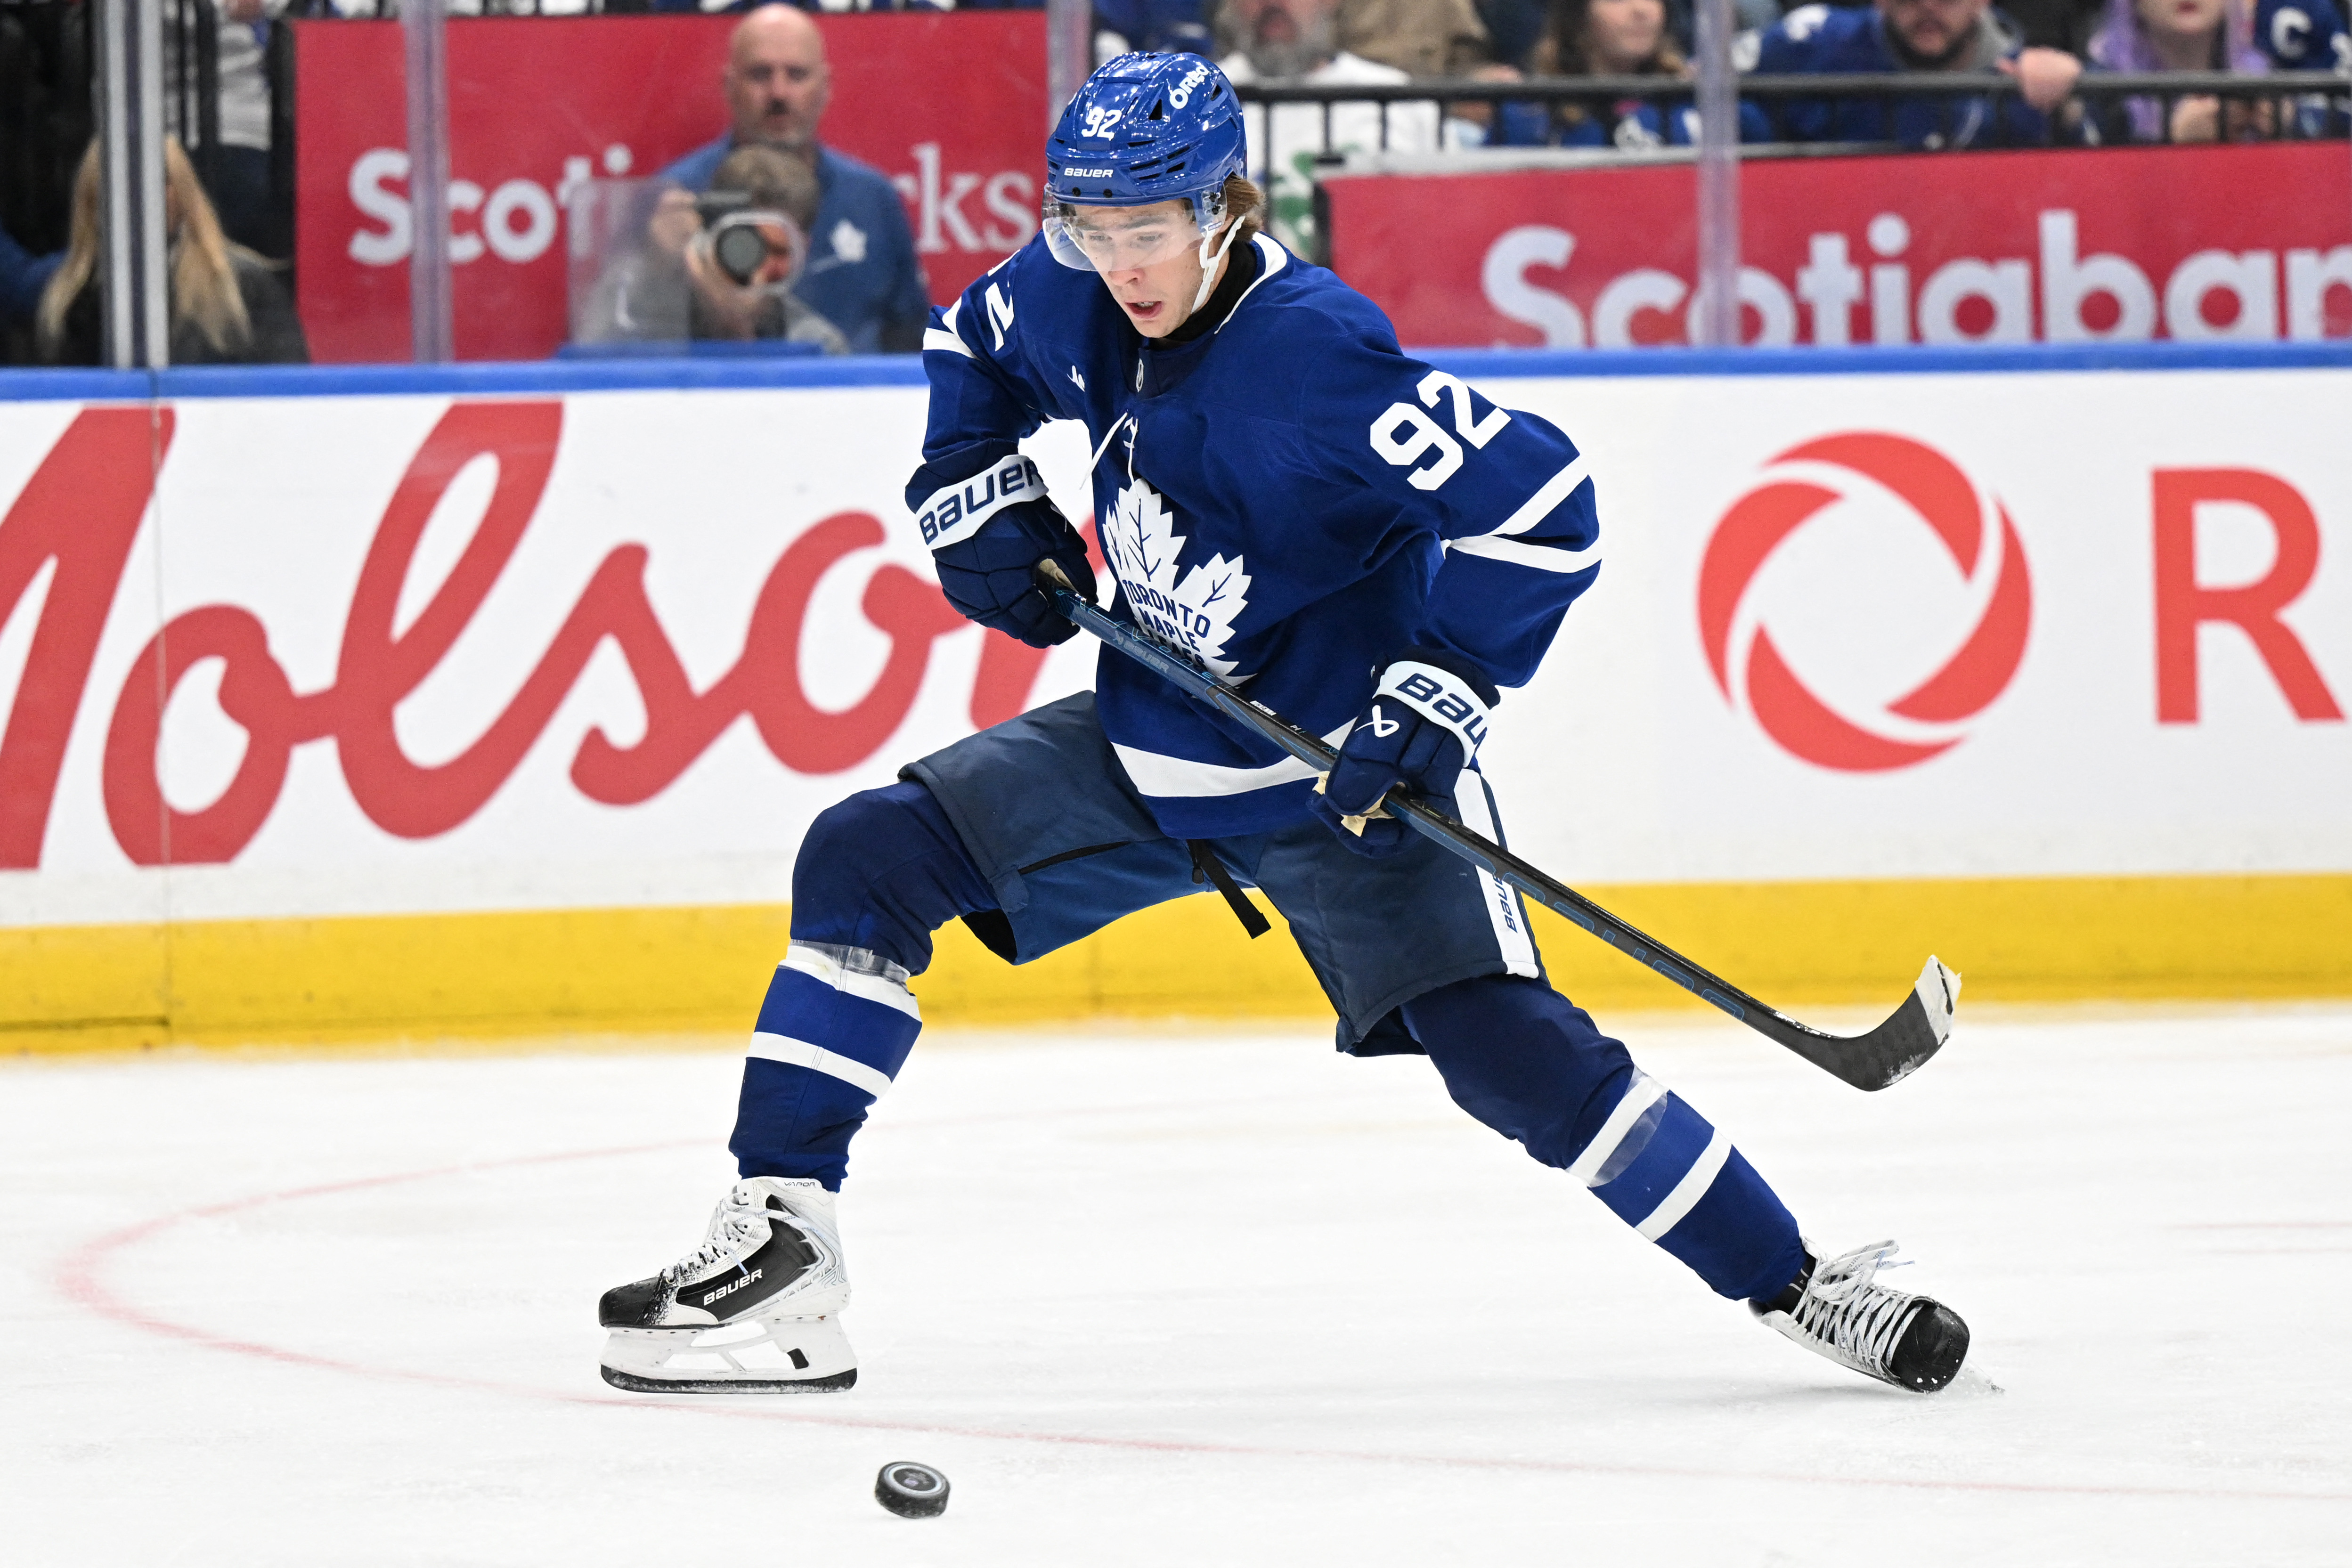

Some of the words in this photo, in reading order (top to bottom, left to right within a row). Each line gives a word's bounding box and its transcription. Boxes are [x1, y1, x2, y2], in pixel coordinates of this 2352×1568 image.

[1082, 107, 1122, 139] 92
[1064, 168, 1114, 178] BAUER
[1370, 370, 1511, 490] 92
[920, 460, 1044, 545] BAUER
[1123, 580, 1210, 638] TORONTO
[1138, 606, 1201, 652] MAPLE
[704, 1268, 763, 1306] BAUER
